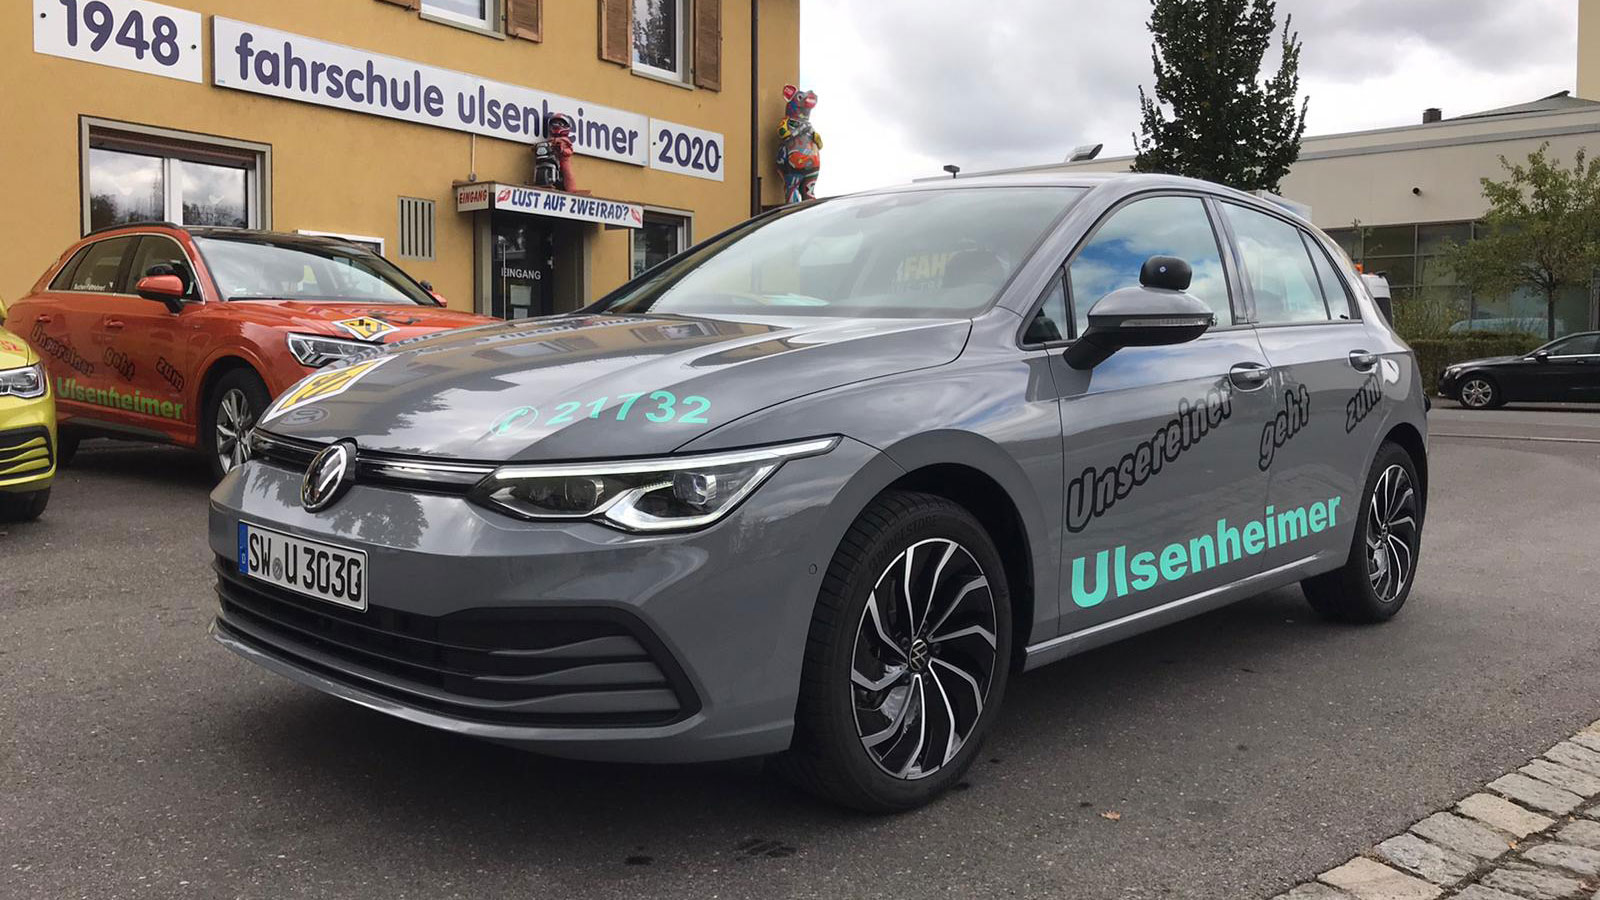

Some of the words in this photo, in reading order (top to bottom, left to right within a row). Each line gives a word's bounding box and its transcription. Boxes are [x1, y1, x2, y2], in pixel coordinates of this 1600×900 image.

[60, 0, 180, 66] 1948
[235, 32, 444, 118] fahrschule
[658, 129, 720, 173] 2020
[459, 187, 488, 205] EINGANG
[511, 188, 541, 208] LUST
[543, 194, 566, 212] AUF
[569, 197, 630, 221] ZWEIRAD?
[501, 267, 542, 280] EINGANG
[30, 322, 95, 378] Unsereiner
[103, 346, 137, 382] geht
[154, 356, 185, 393] zum
[56, 375, 185, 420] Ulsenheimer
[543, 390, 712, 426] 21732
[1065, 378, 1234, 534] Unsereiner
[1257, 383, 1312, 472] geht
[1344, 373, 1383, 434] zum
[249, 532, 272, 577] SW
[284, 542, 297, 585] U
[1070, 494, 1342, 608] Ulsenheimer
